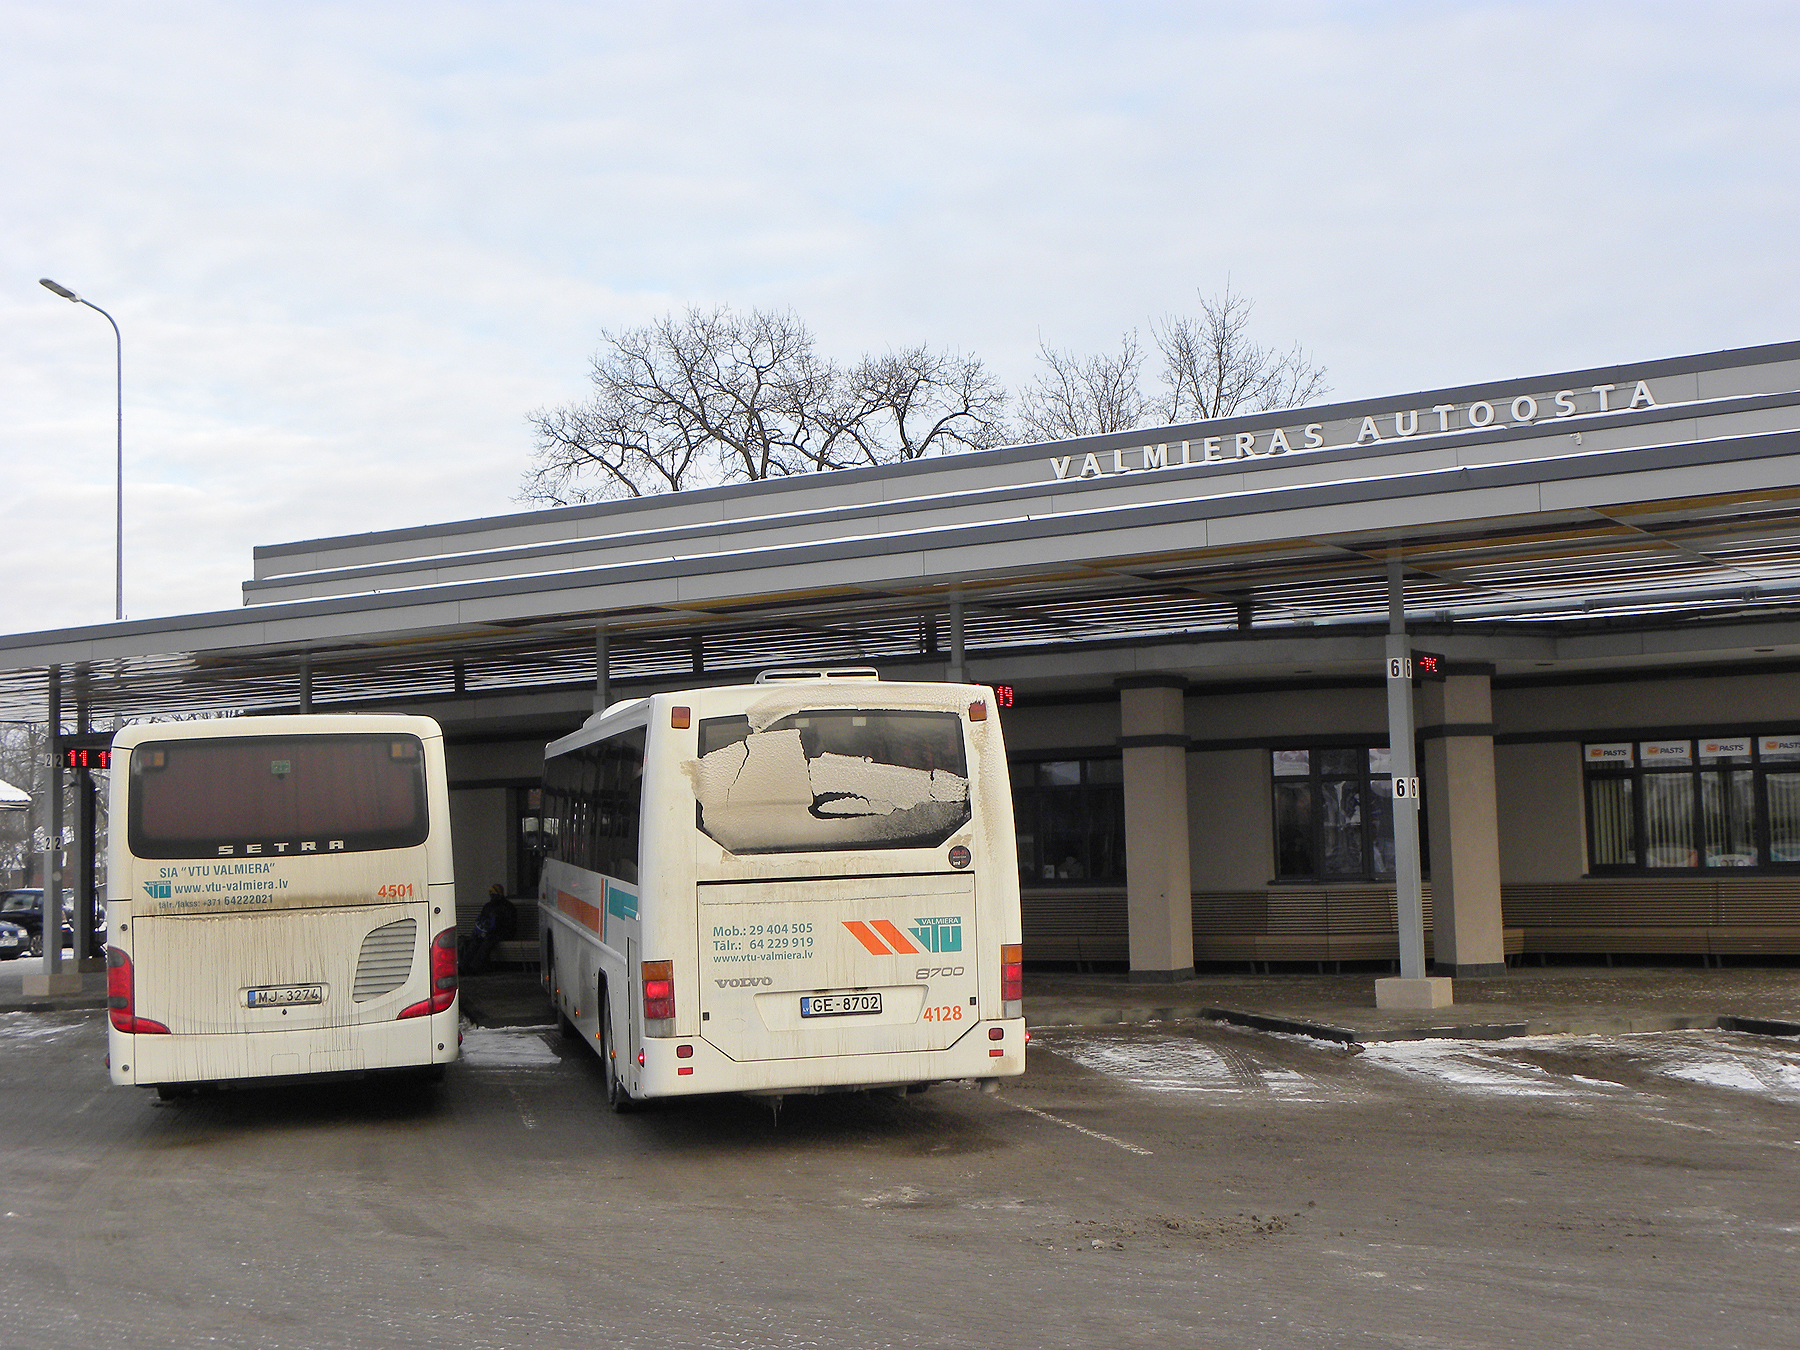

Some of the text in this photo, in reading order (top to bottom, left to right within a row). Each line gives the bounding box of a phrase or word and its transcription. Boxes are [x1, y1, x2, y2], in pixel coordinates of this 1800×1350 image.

[1050, 380, 1655, 479] VALMIERAS AUTOOSTA
[1391, 659, 1399, 677] 6
[996, 685, 1013, 707] 19
[1719, 744, 1744, 752] PASTS
[46, 754, 51, 767] 2
[55, 754, 62, 767] 2
[67, 749, 88, 767] 11
[1396, 778, 1405, 797] 6
[45, 837, 51, 850] 2
[55, 837, 61, 850] 2
[218, 840, 344, 855] SETRA
[160, 867, 178, 878] SIA
[213, 863, 275, 876] VALMIERA"
[174, 879, 288, 894] www.vtu-valmiera.lv
[377, 883, 413, 898] 4501
[224, 894, 273, 905] 64222021
[921, 917, 959, 925] VALMIERA
[713, 922, 813, 937] Mob.: 29 404 505
[713, 937, 814, 951] Tālr.: 64 229 919
[713, 950, 813, 963] www.vtu-valmiera.lv
[915, 966, 965, 980] 8700
[715, 976, 773, 989] VOLVO
[258, 989, 319, 1004] MJ-3274
[812, 996, 879, 1013] GE-8702
[923, 1005, 963, 1022] 4128
